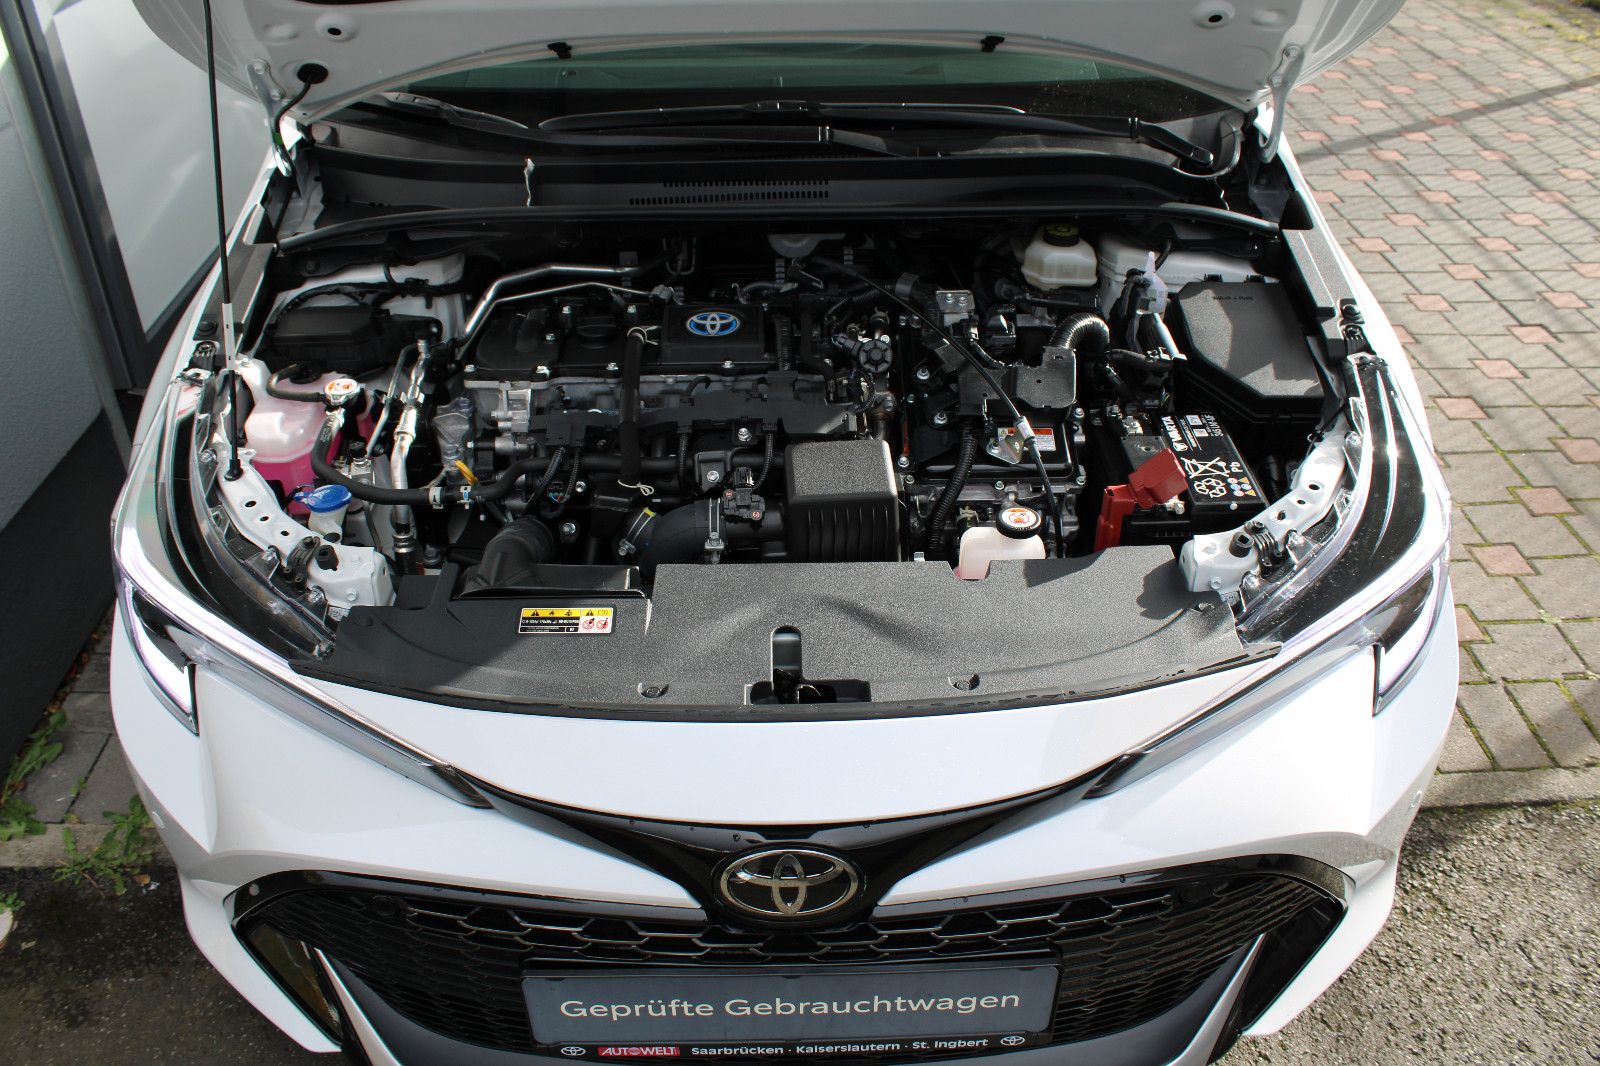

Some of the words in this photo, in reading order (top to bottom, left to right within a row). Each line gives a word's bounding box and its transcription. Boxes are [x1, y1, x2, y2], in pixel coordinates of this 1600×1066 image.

[1161, 415, 1183, 441] VARTA
[1229, 461, 1244, 473] Pb
[560, 999, 714, 1021] Geprüfte
[724, 995, 1020, 1016] Gebrauchtwagen
[601, 1046, 676, 1056] AUTOWELT
[691, 1046, 784, 1055] Saarbrücken
[796, 1043, 900, 1054] Kaiserslautern
[912, 1041, 931, 1049] St.
[934, 1038, 989, 1049] Ingbert
